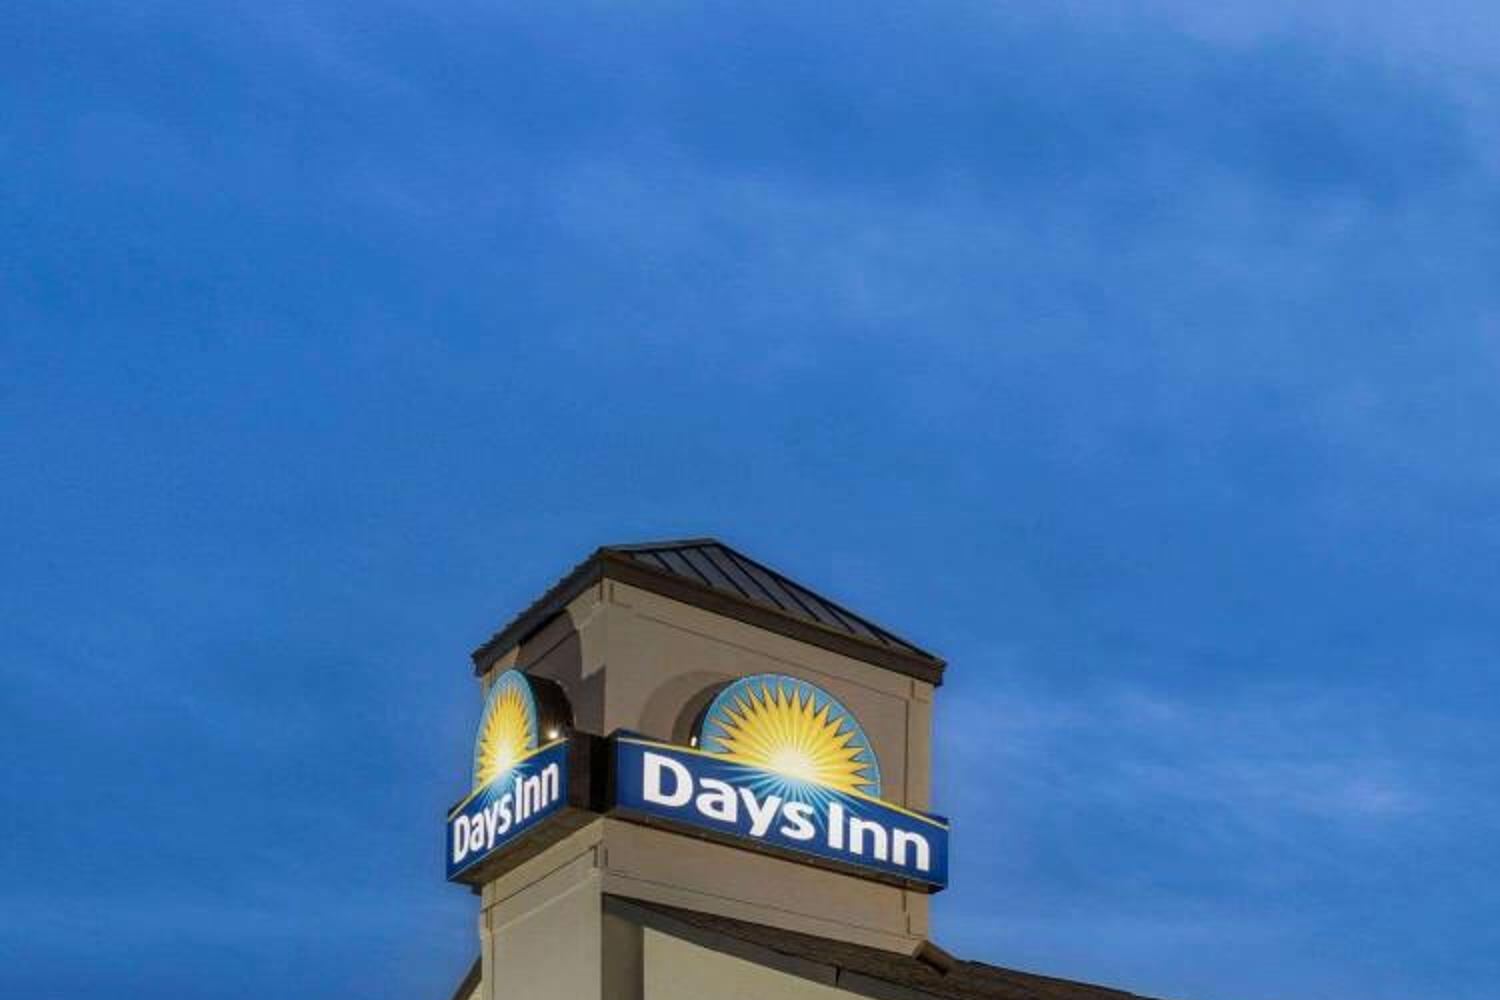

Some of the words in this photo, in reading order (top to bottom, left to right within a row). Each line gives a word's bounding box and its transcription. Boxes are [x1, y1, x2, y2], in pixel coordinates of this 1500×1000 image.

[454, 793, 512, 864] Days
[515, 763, 559, 824] Inn
[643, 752, 816, 840] Days
[828, 801, 930, 872] Inn
